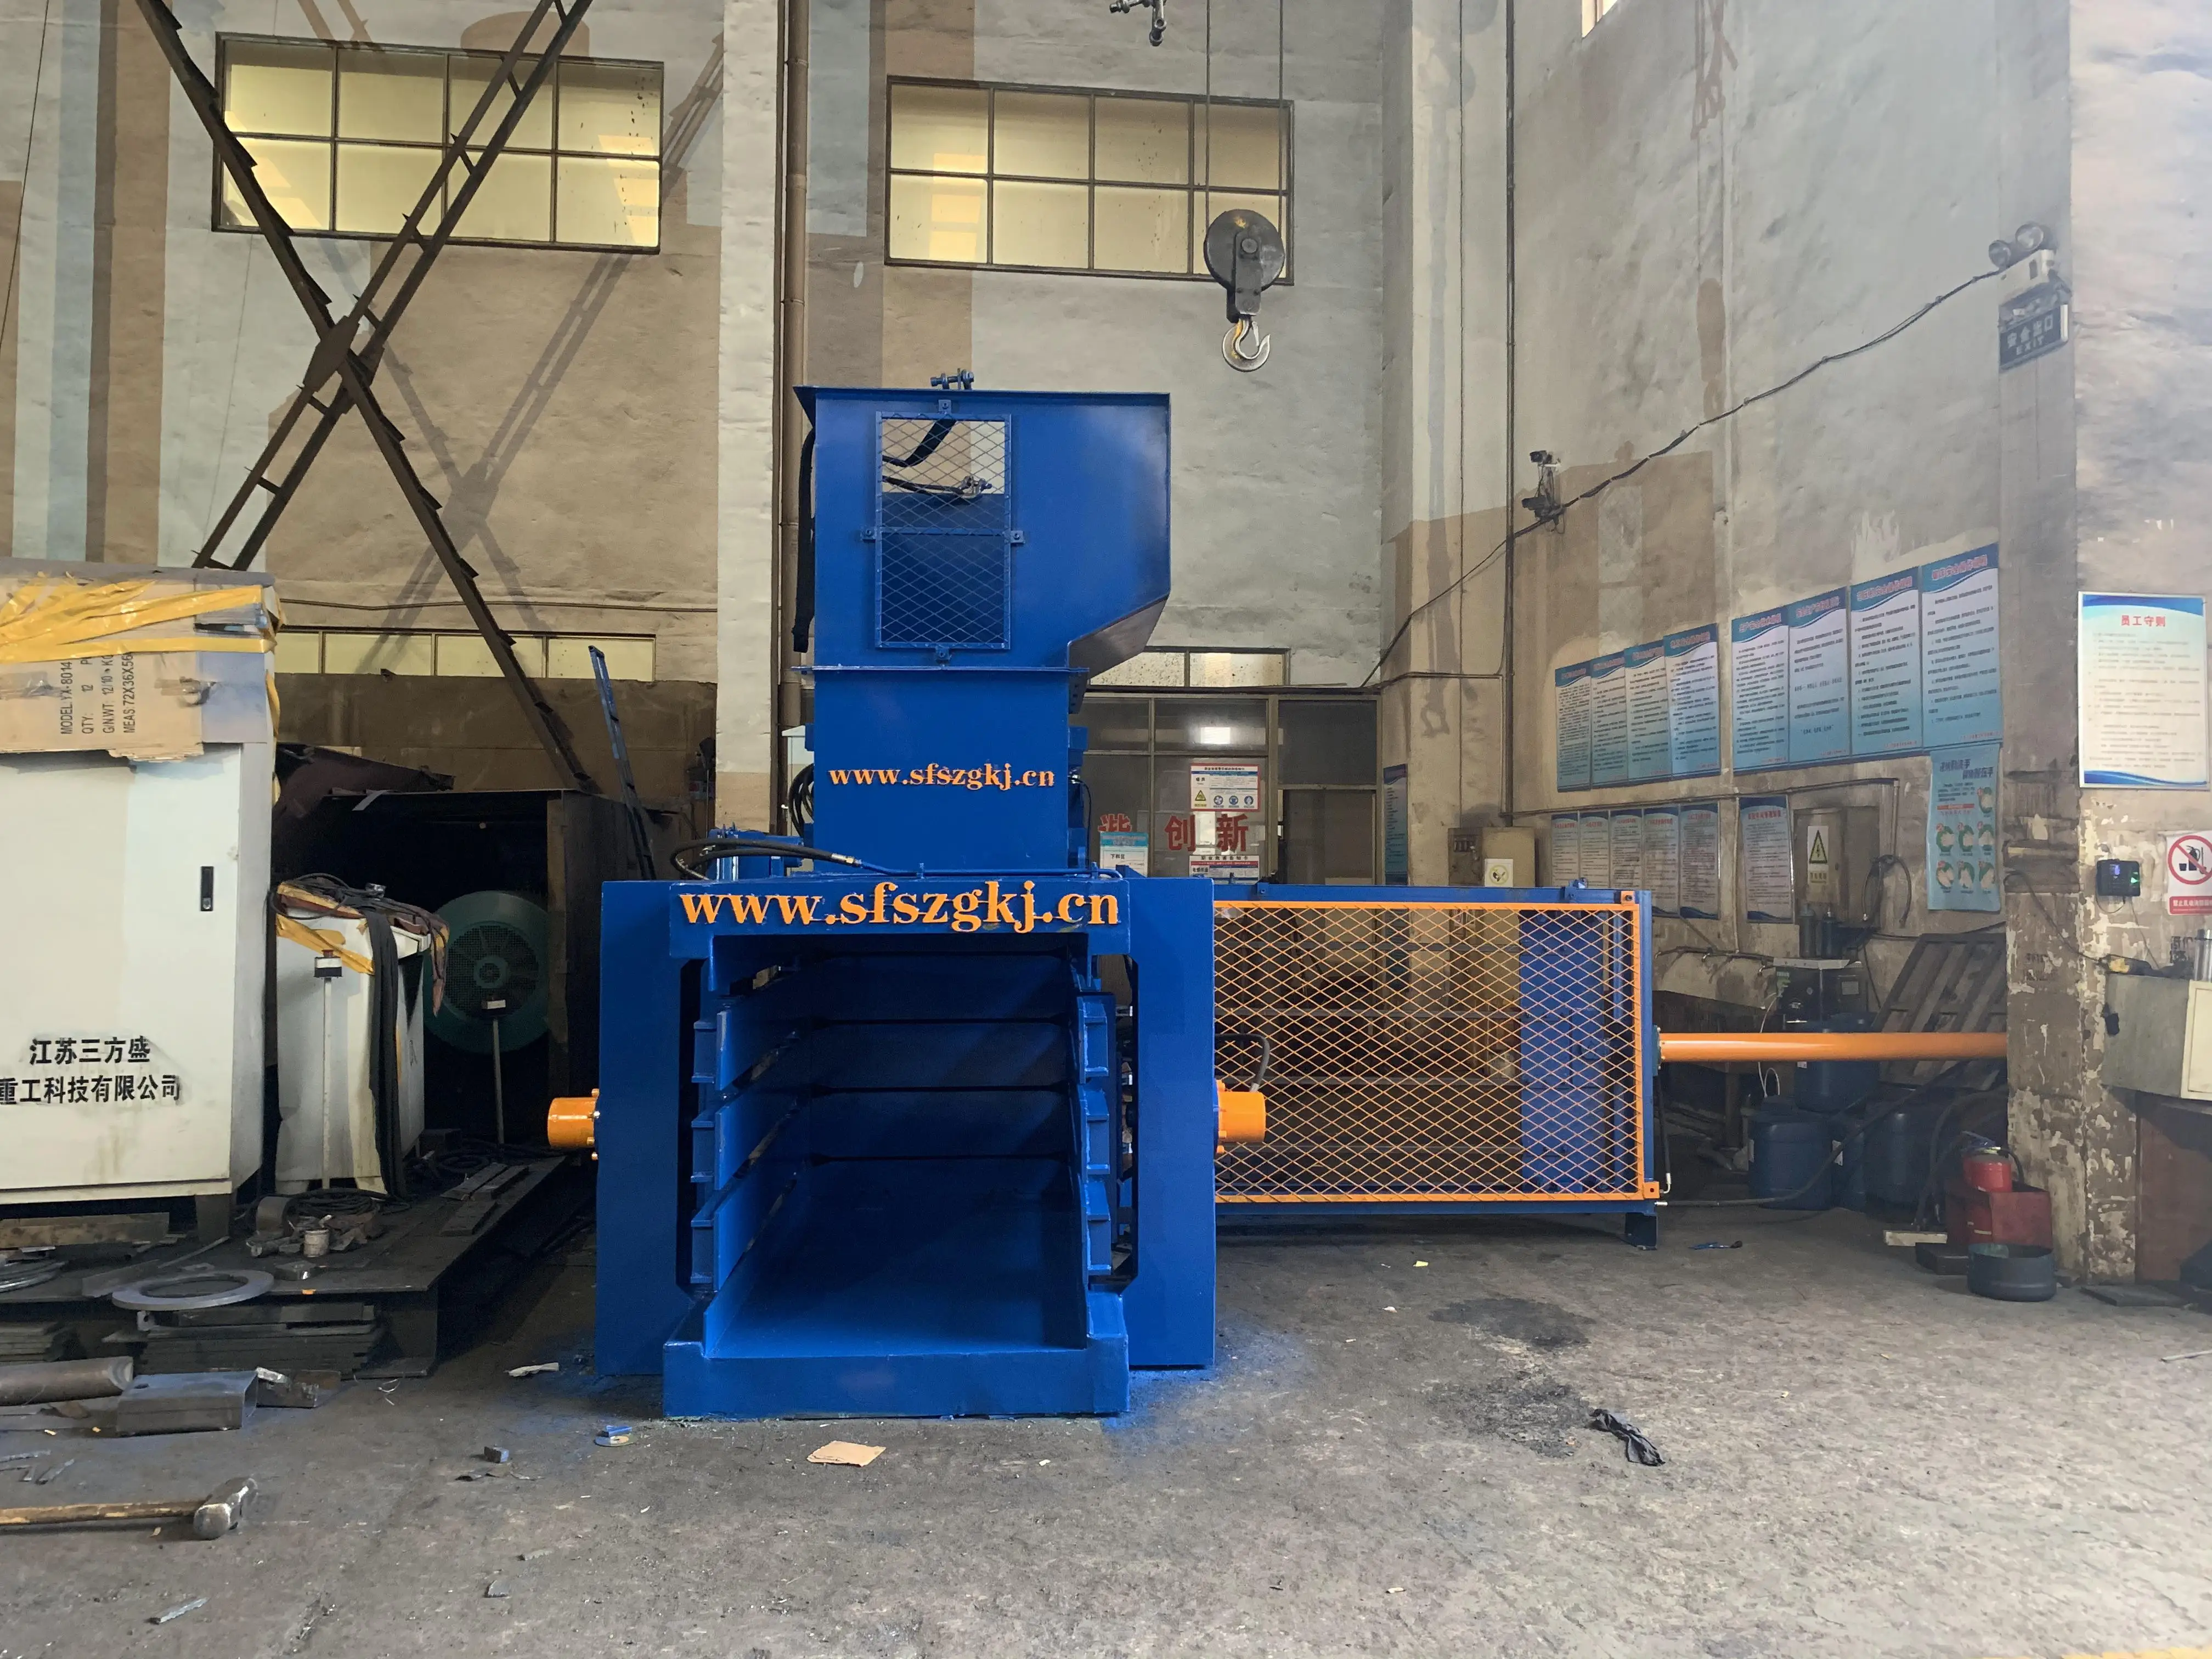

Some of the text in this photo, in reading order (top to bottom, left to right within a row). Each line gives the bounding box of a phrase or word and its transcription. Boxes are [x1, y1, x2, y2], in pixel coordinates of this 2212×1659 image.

[2016, 335, 2045, 356] EXIT
[2121, 614, 2166, 627] 员工守则
[828, 763, 1054, 791] www.sfszgkj.cn
[1164, 814, 1249, 852] 创新
[680, 881, 1118, 934] www.sfszgkj.cn
[29, 1035, 151, 1065] 江苏三方盛
[0, 1074, 182, 1105] 重工科技有限公司
